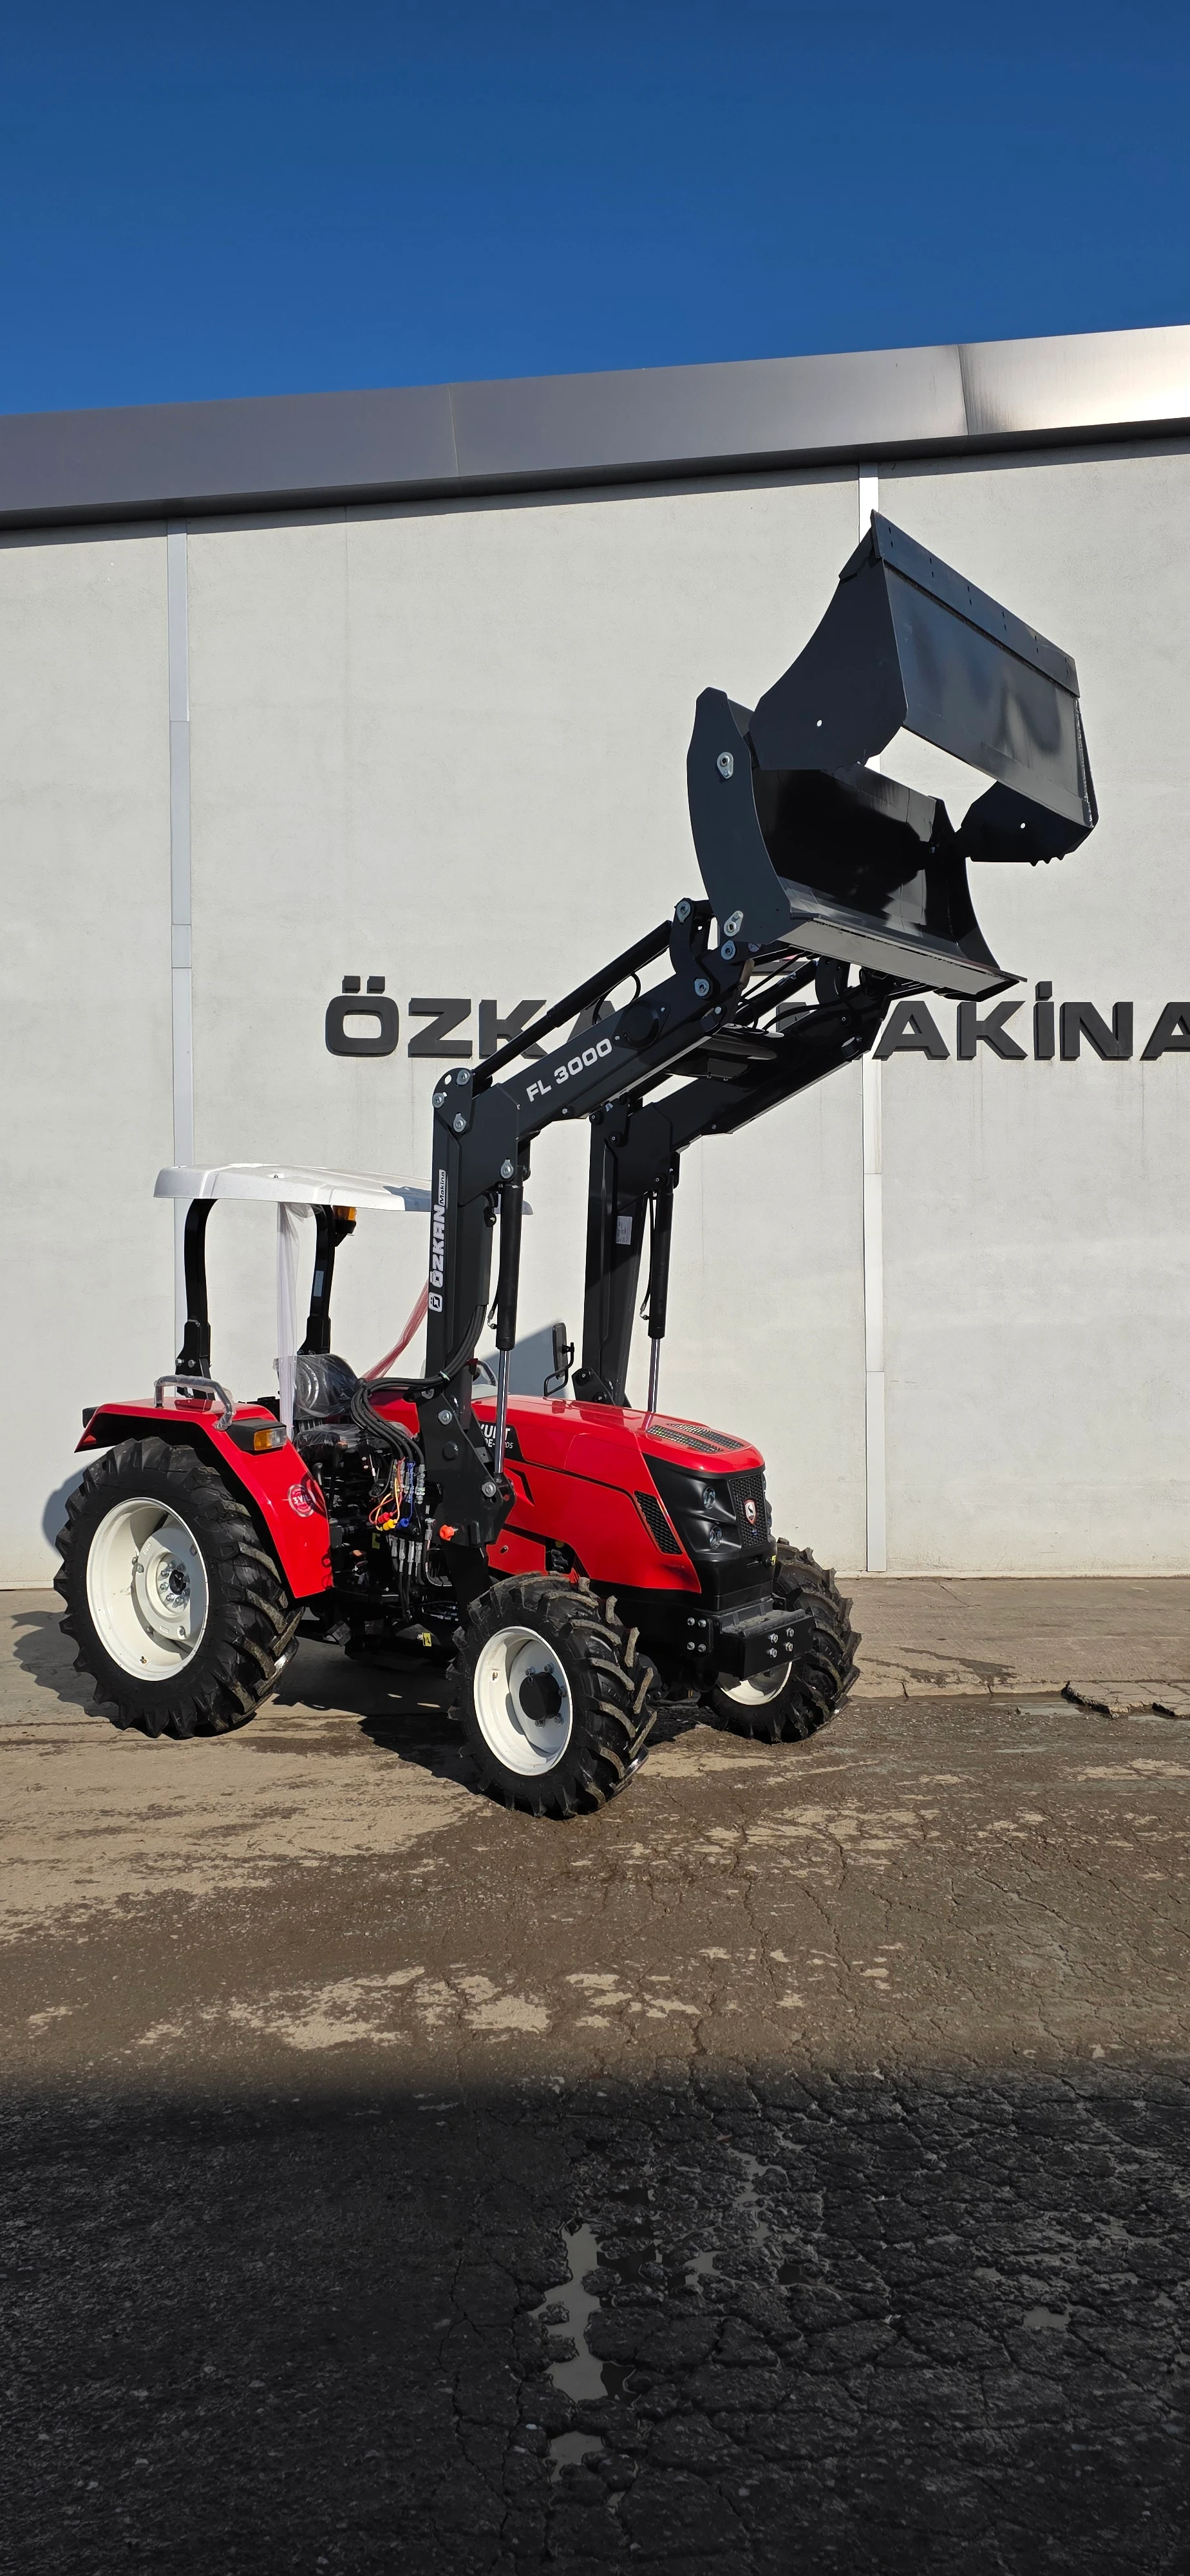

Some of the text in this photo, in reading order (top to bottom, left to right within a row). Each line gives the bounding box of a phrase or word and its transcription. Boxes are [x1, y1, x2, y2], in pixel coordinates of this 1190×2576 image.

[526, 1038, 612, 1103] FL 3000
[430, 1204, 446, 1288] ÖZKAN
